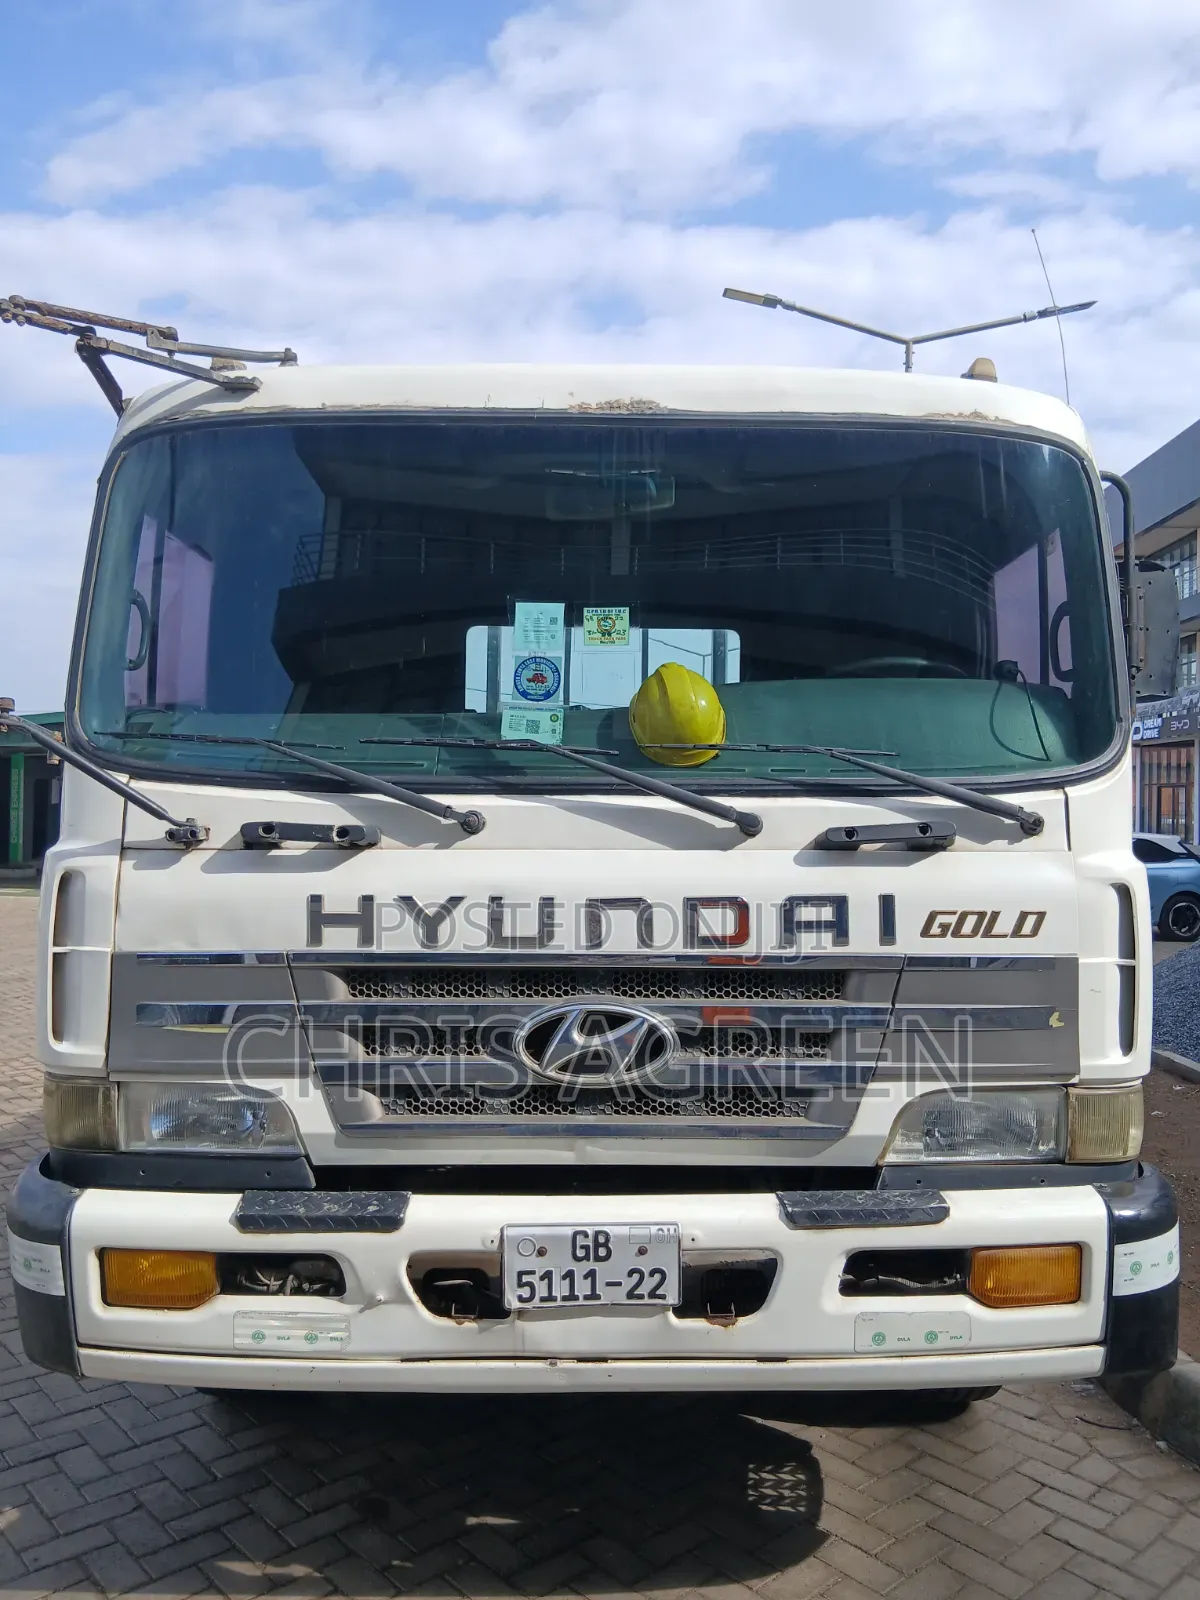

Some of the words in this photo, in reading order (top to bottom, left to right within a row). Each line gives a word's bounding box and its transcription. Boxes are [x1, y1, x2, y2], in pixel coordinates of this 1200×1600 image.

[1143, 718, 1162, 729] DREAM
[1143, 729, 1160, 739] DRIVE
[1170, 720, 1189, 731] BYD
[11, 768, 19, 808] EXPRESS
[305, 893, 897, 949] HYUNDAI
[919, 909, 1047, 939] GOLD
[571, 1229, 613, 1263] GB
[655, 1227, 678, 1244] GH
[516, 1267, 668, 1304] 5111-22
